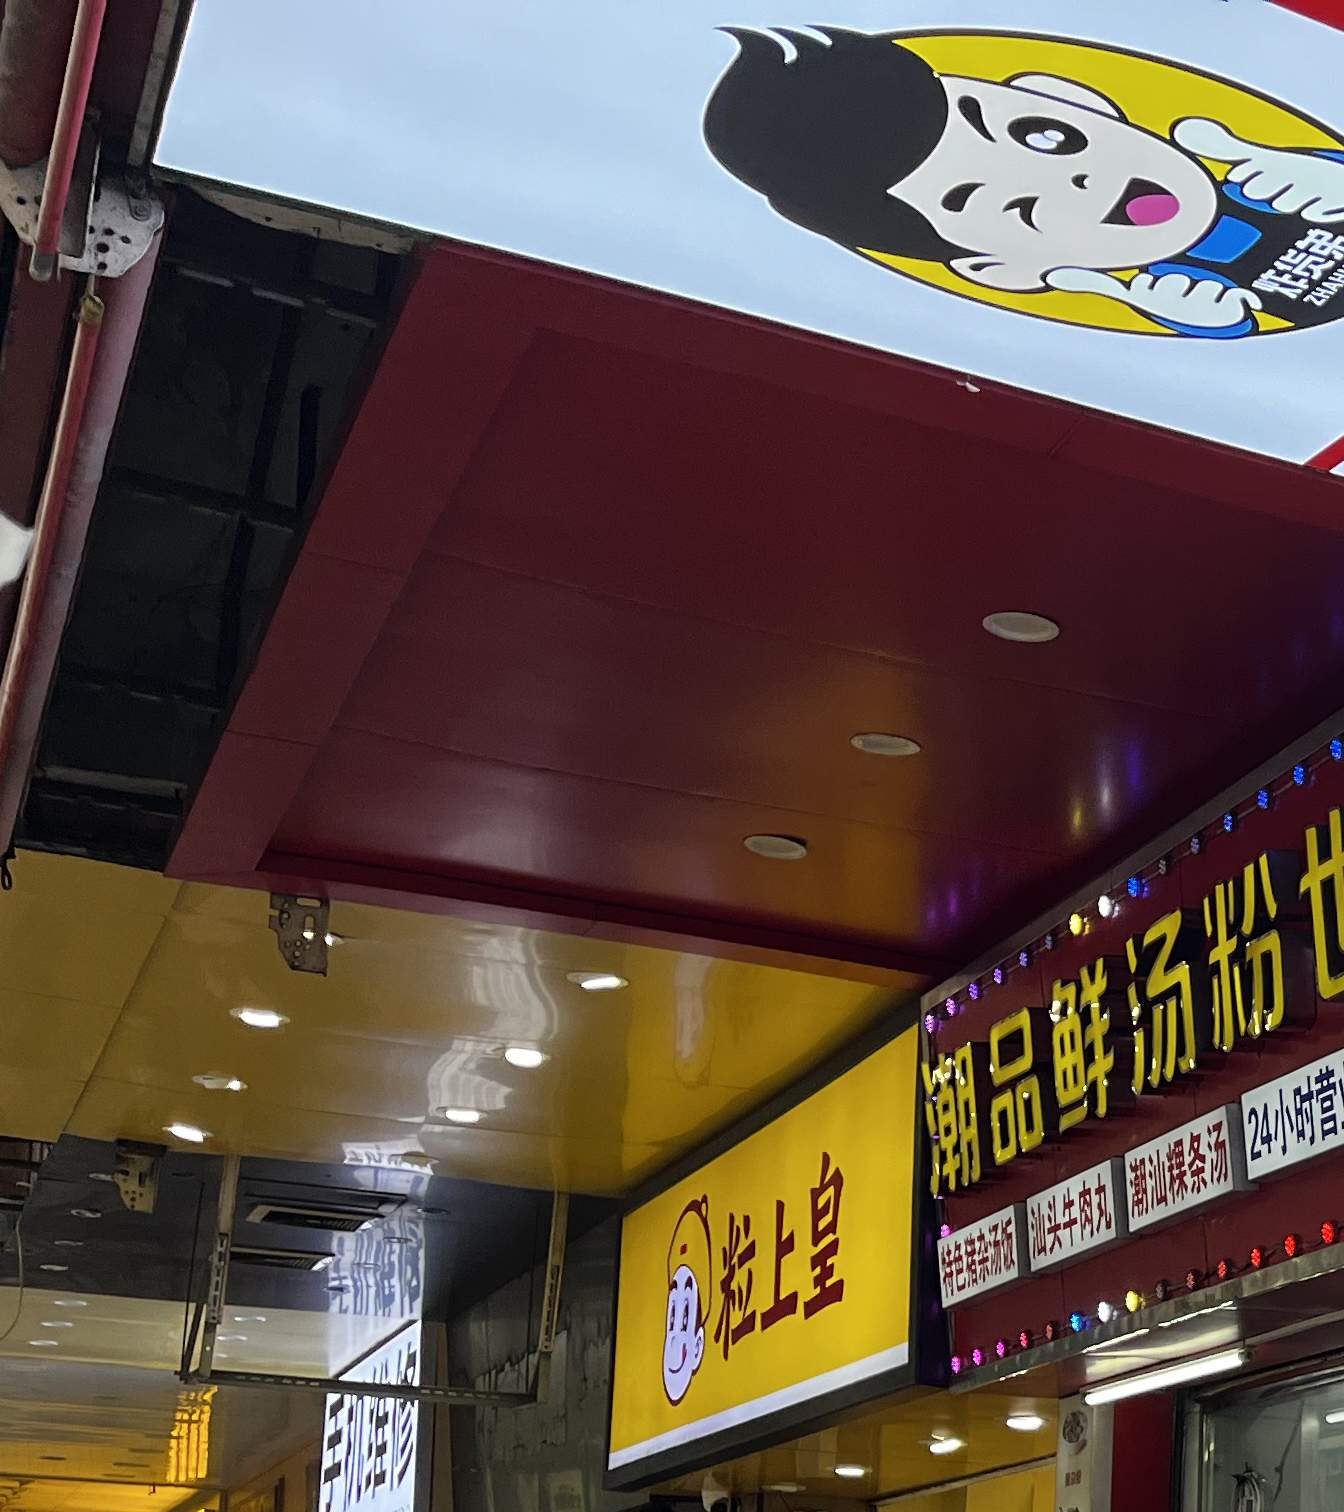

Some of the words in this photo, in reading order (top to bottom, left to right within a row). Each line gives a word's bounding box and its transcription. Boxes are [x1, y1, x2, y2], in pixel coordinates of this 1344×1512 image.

[1031, 1172, 1112, 1259] 汕头牛肉丸
[1129, 1120, 1229, 1219] 潮汕粿条汤
[713, 1151, 845, 1360] 粒上皇
[941, 1215, 1016, 1298] 特色猪杂汤饭
